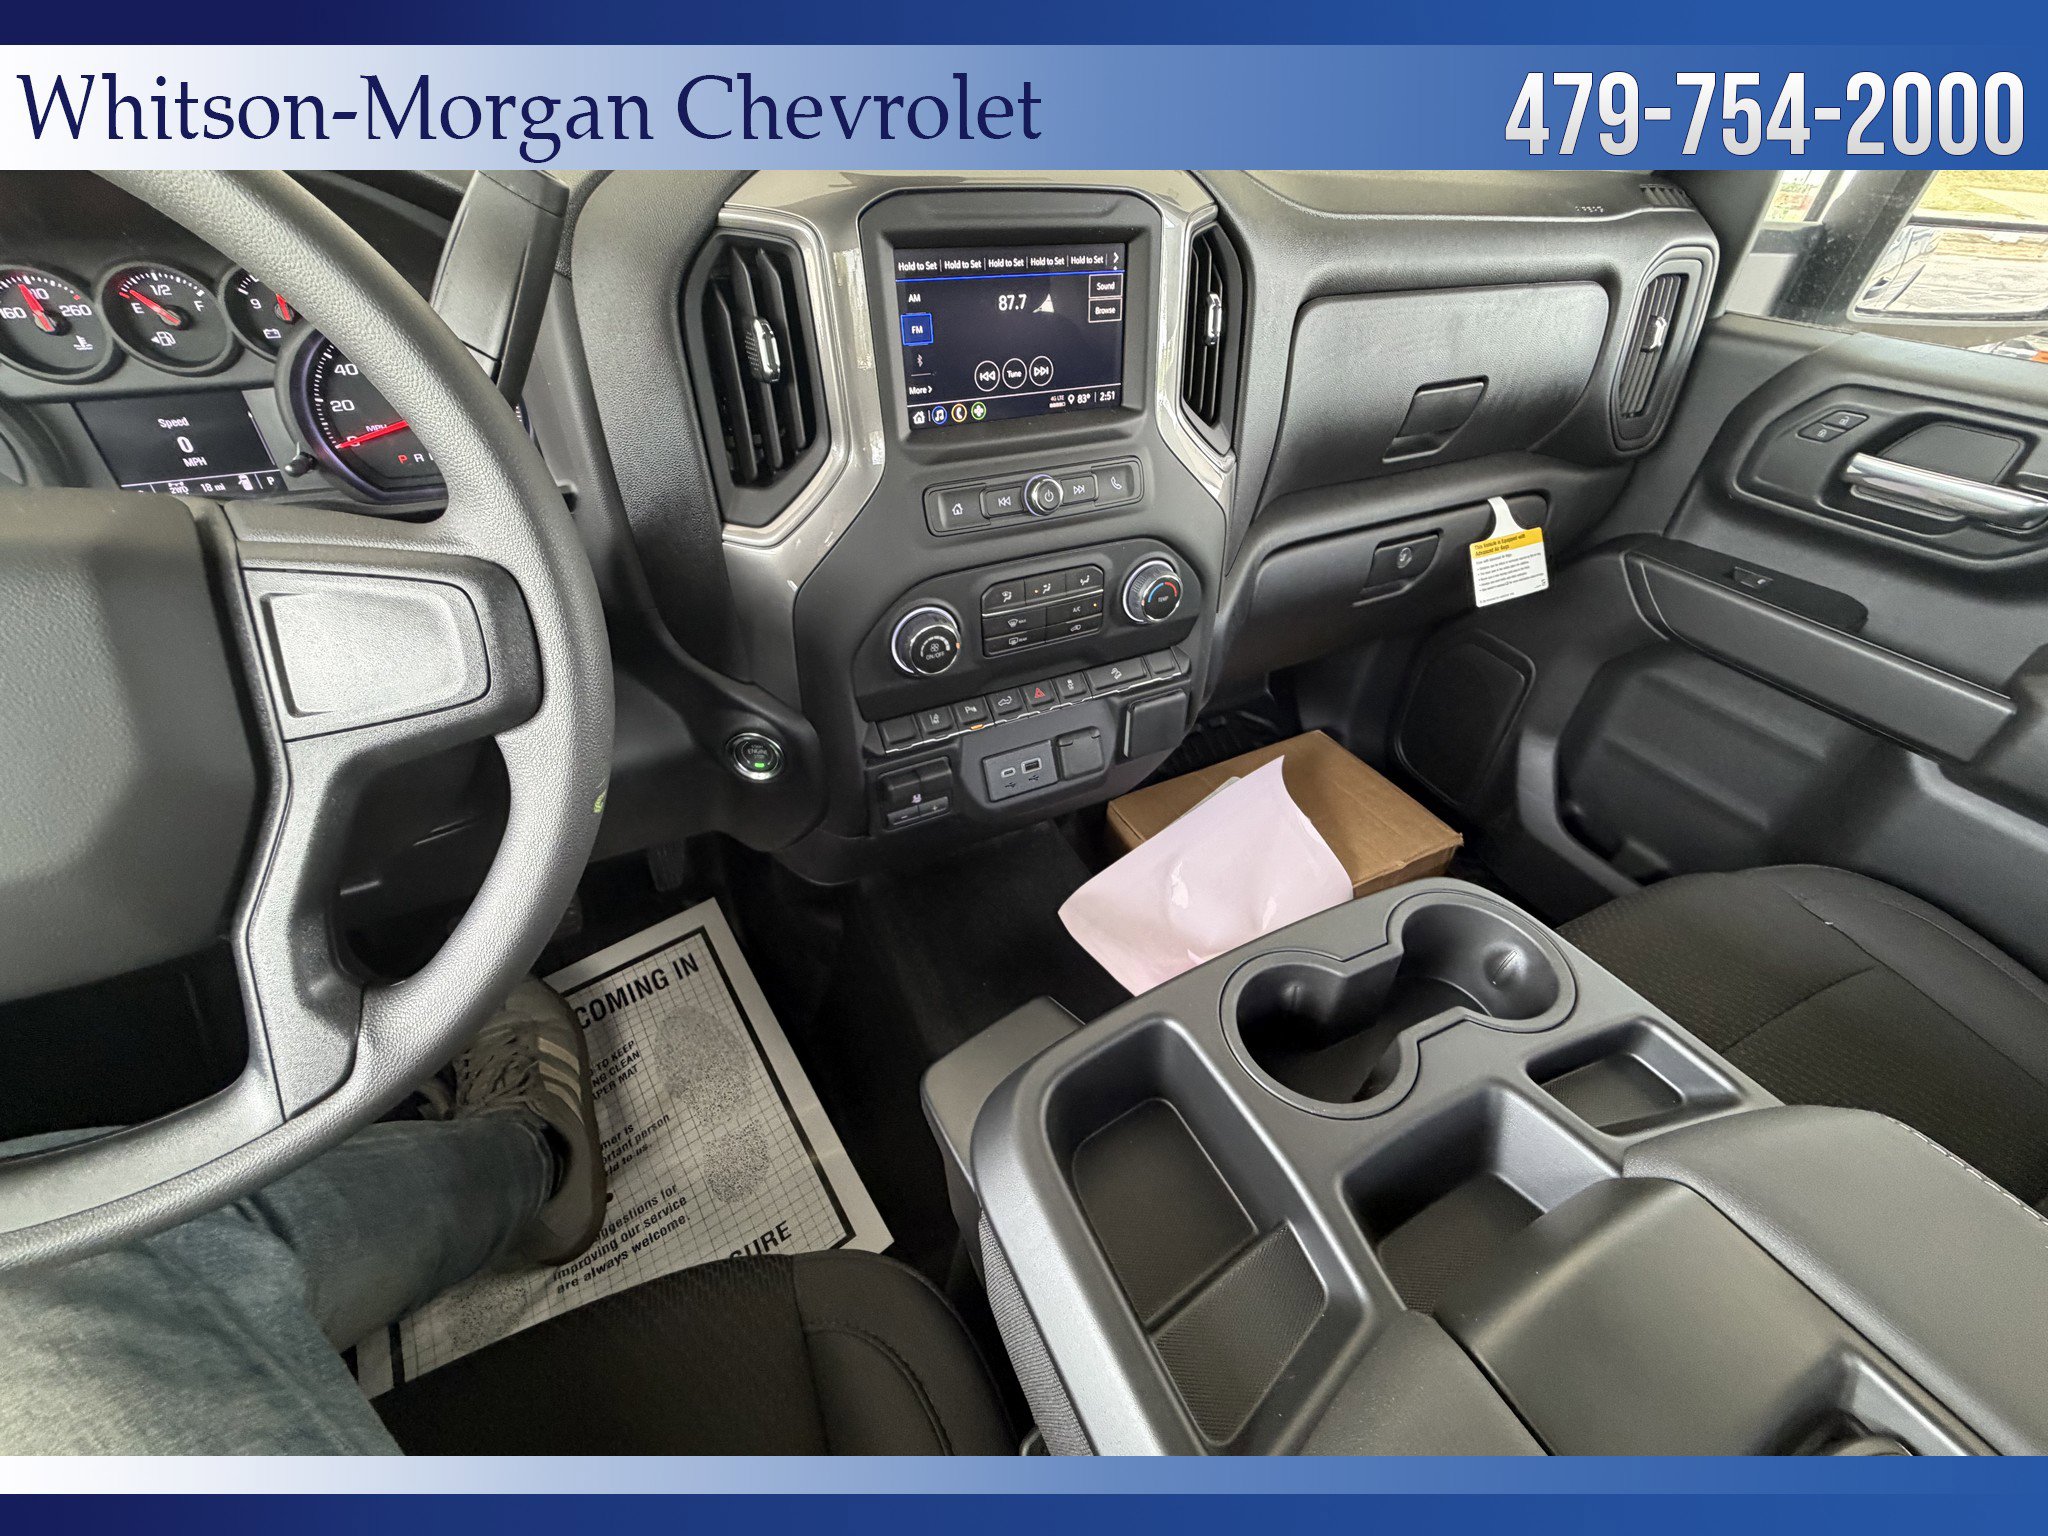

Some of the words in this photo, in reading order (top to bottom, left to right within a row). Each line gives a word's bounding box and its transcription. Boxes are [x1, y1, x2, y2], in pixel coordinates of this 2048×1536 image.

[898, 262, 915, 271] Hold
[916, 262, 925, 270] to
[925, 261, 938, 270] Set
[944, 260, 961, 269] Hold
[962, 260, 970, 269] to
[970, 259, 982, 269] Set
[988, 258, 1004, 268] Hold
[1005, 258, 1013, 267] to
[1013, 258, 1024, 267] Set
[1030, 257, 1046, 266] Hold
[1046, 257, 1054, 266] to
[1054, 256, 1065, 265] Set
[1070, 256, 1085, 265] Hold
[1086, 256, 1093, 264] to
[1093, 255, 1104, 264] Set
[150, 284, 173, 296] 1/2
[1096, 281, 1115, 291] Sound
[250, 298, 262, 310] 9
[908, 293, 921, 303] AM
[998, 293, 1028, 311] 87.7
[59, 304, 92, 317] 260
[131, 302, 144, 314] E
[194, 300, 205, 312] F
[1094, 306, 1116, 315] Browse
[0, 307, 27, 319] 160
[911, 325, 924, 335] FM
[334, 363, 359, 376] 40
[1006, 370, 1022, 379] Tune
[909, 386, 928, 395] More
[1099, 391, 1115, 402] 2:51
[330, 400, 355, 412] 20
[157, 416, 190, 429] Speed
[177, 436, 194, 453] 0
[182, 456, 208, 467] MPH
[266, 476, 275, 485] P
[200, 483, 213, 493] 18
[575, 968, 669, 1029] COMING
[672, 952, 699, 980] IN
[597, 1058, 609, 1072] TO
[611, 1040, 634, 1060] KEEP
[609, 1050, 640, 1077] CLEAN
[618, 1064, 638, 1084] MAT
[635, 1114, 670, 1145] person
[622, 1154, 633, 1166] to
[660, 1184, 678, 1200] for
[620, 1223, 641, 1243] our
[644, 1196, 687, 1228] service
[557, 1278, 579, 1294] are
[583, 1250, 629, 1282] always
[631, 1215, 690, 1254] welcome.
